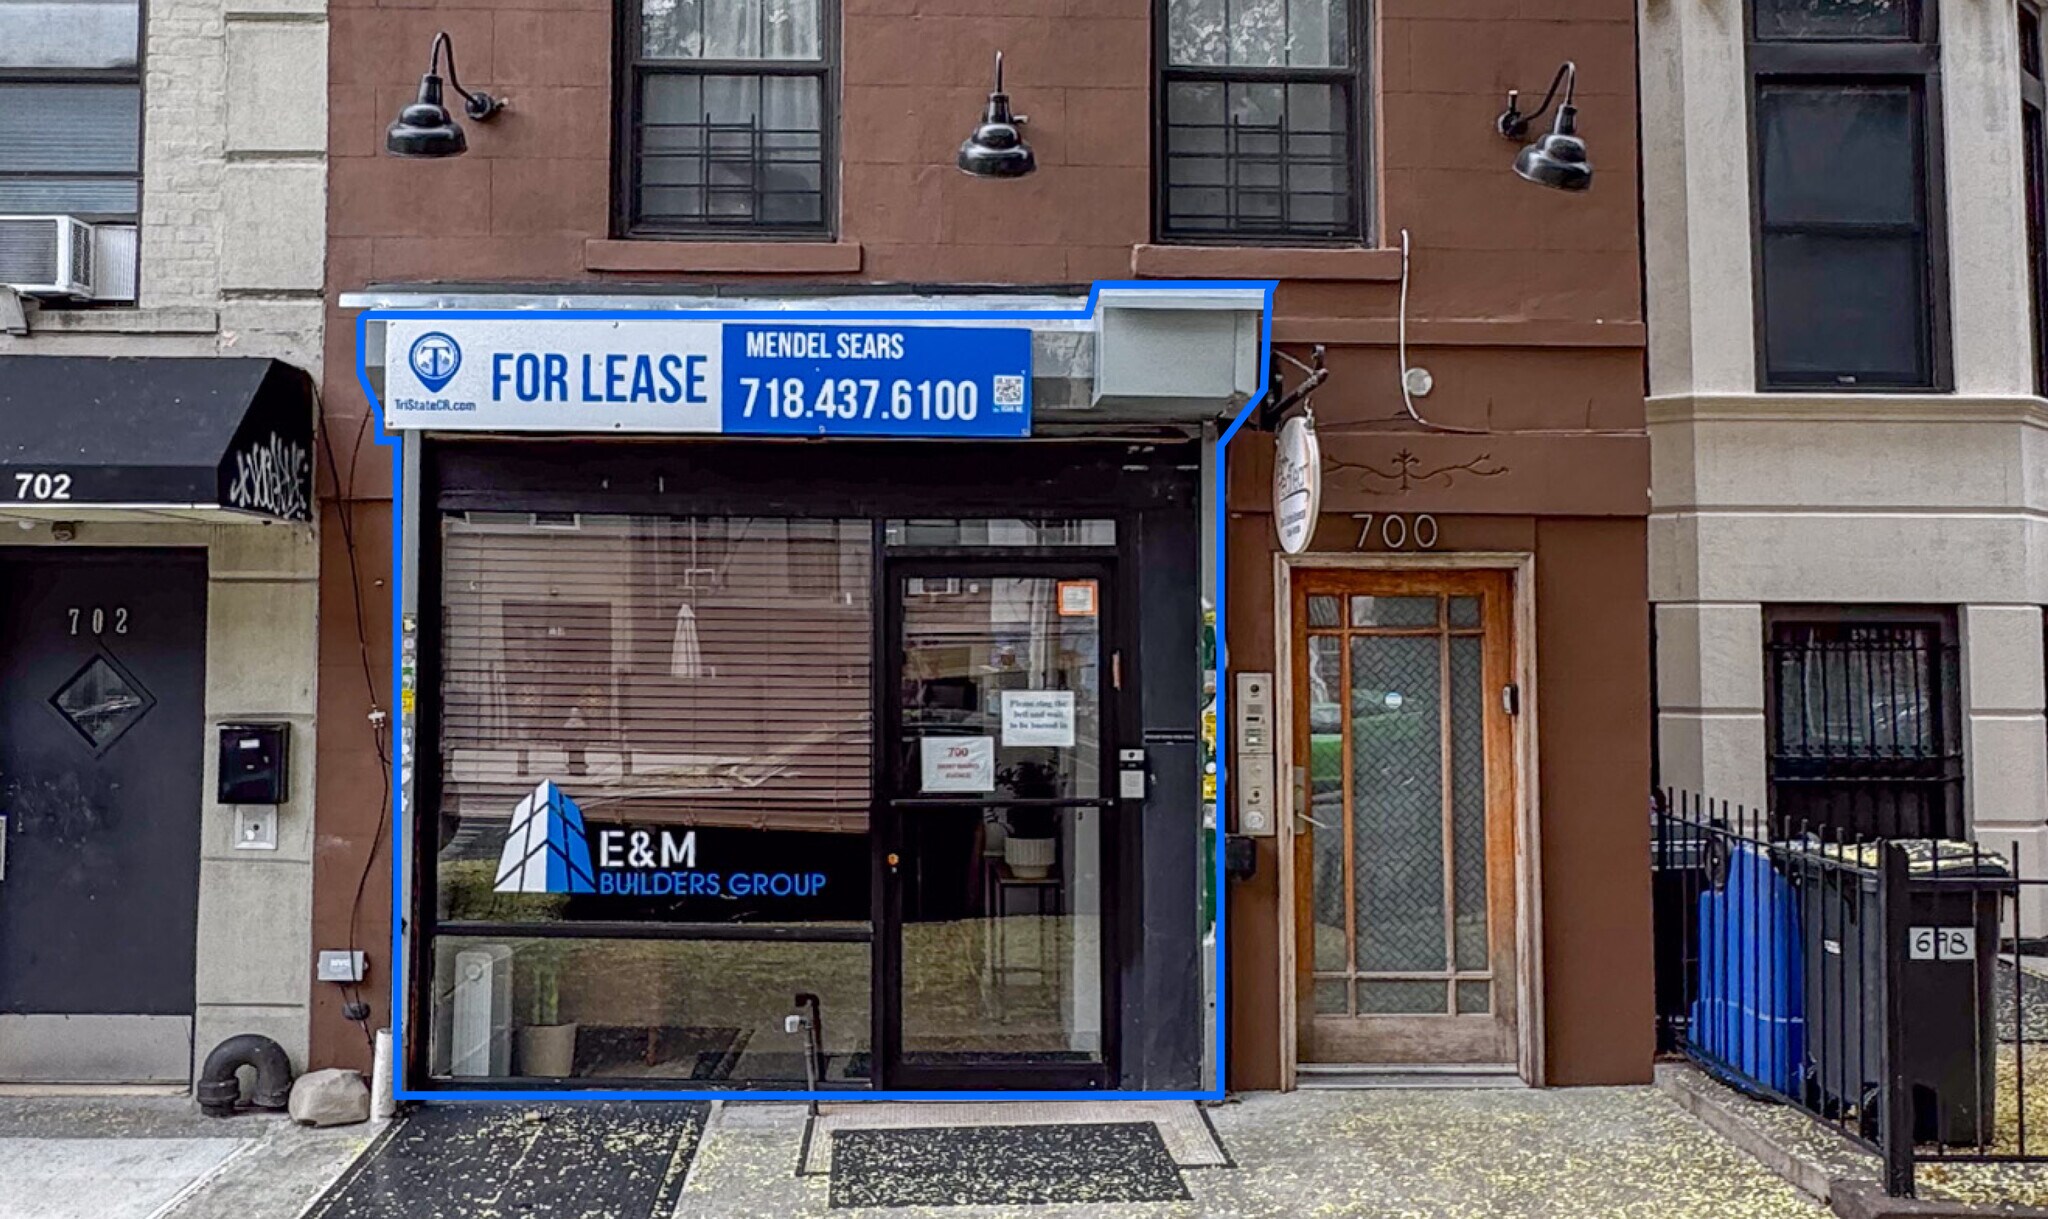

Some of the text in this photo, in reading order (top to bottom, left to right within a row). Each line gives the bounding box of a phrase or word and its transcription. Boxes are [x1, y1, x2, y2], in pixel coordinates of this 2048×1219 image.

[746, 331, 904, 359] MENDEL SEARS
[492, 353, 708, 403] FOR LEASE
[739, 377, 978, 421] 718.437.6100
[15, 473, 72, 499] 702
[1352, 514, 1438, 548] 700
[68, 608, 128, 635] 702
[947, 747, 969, 757] 700
[600, 830, 696, 869] E&M
[600, 872, 827, 896] BUILDERS GROUP
[1915, 931, 1969, 955] 698
